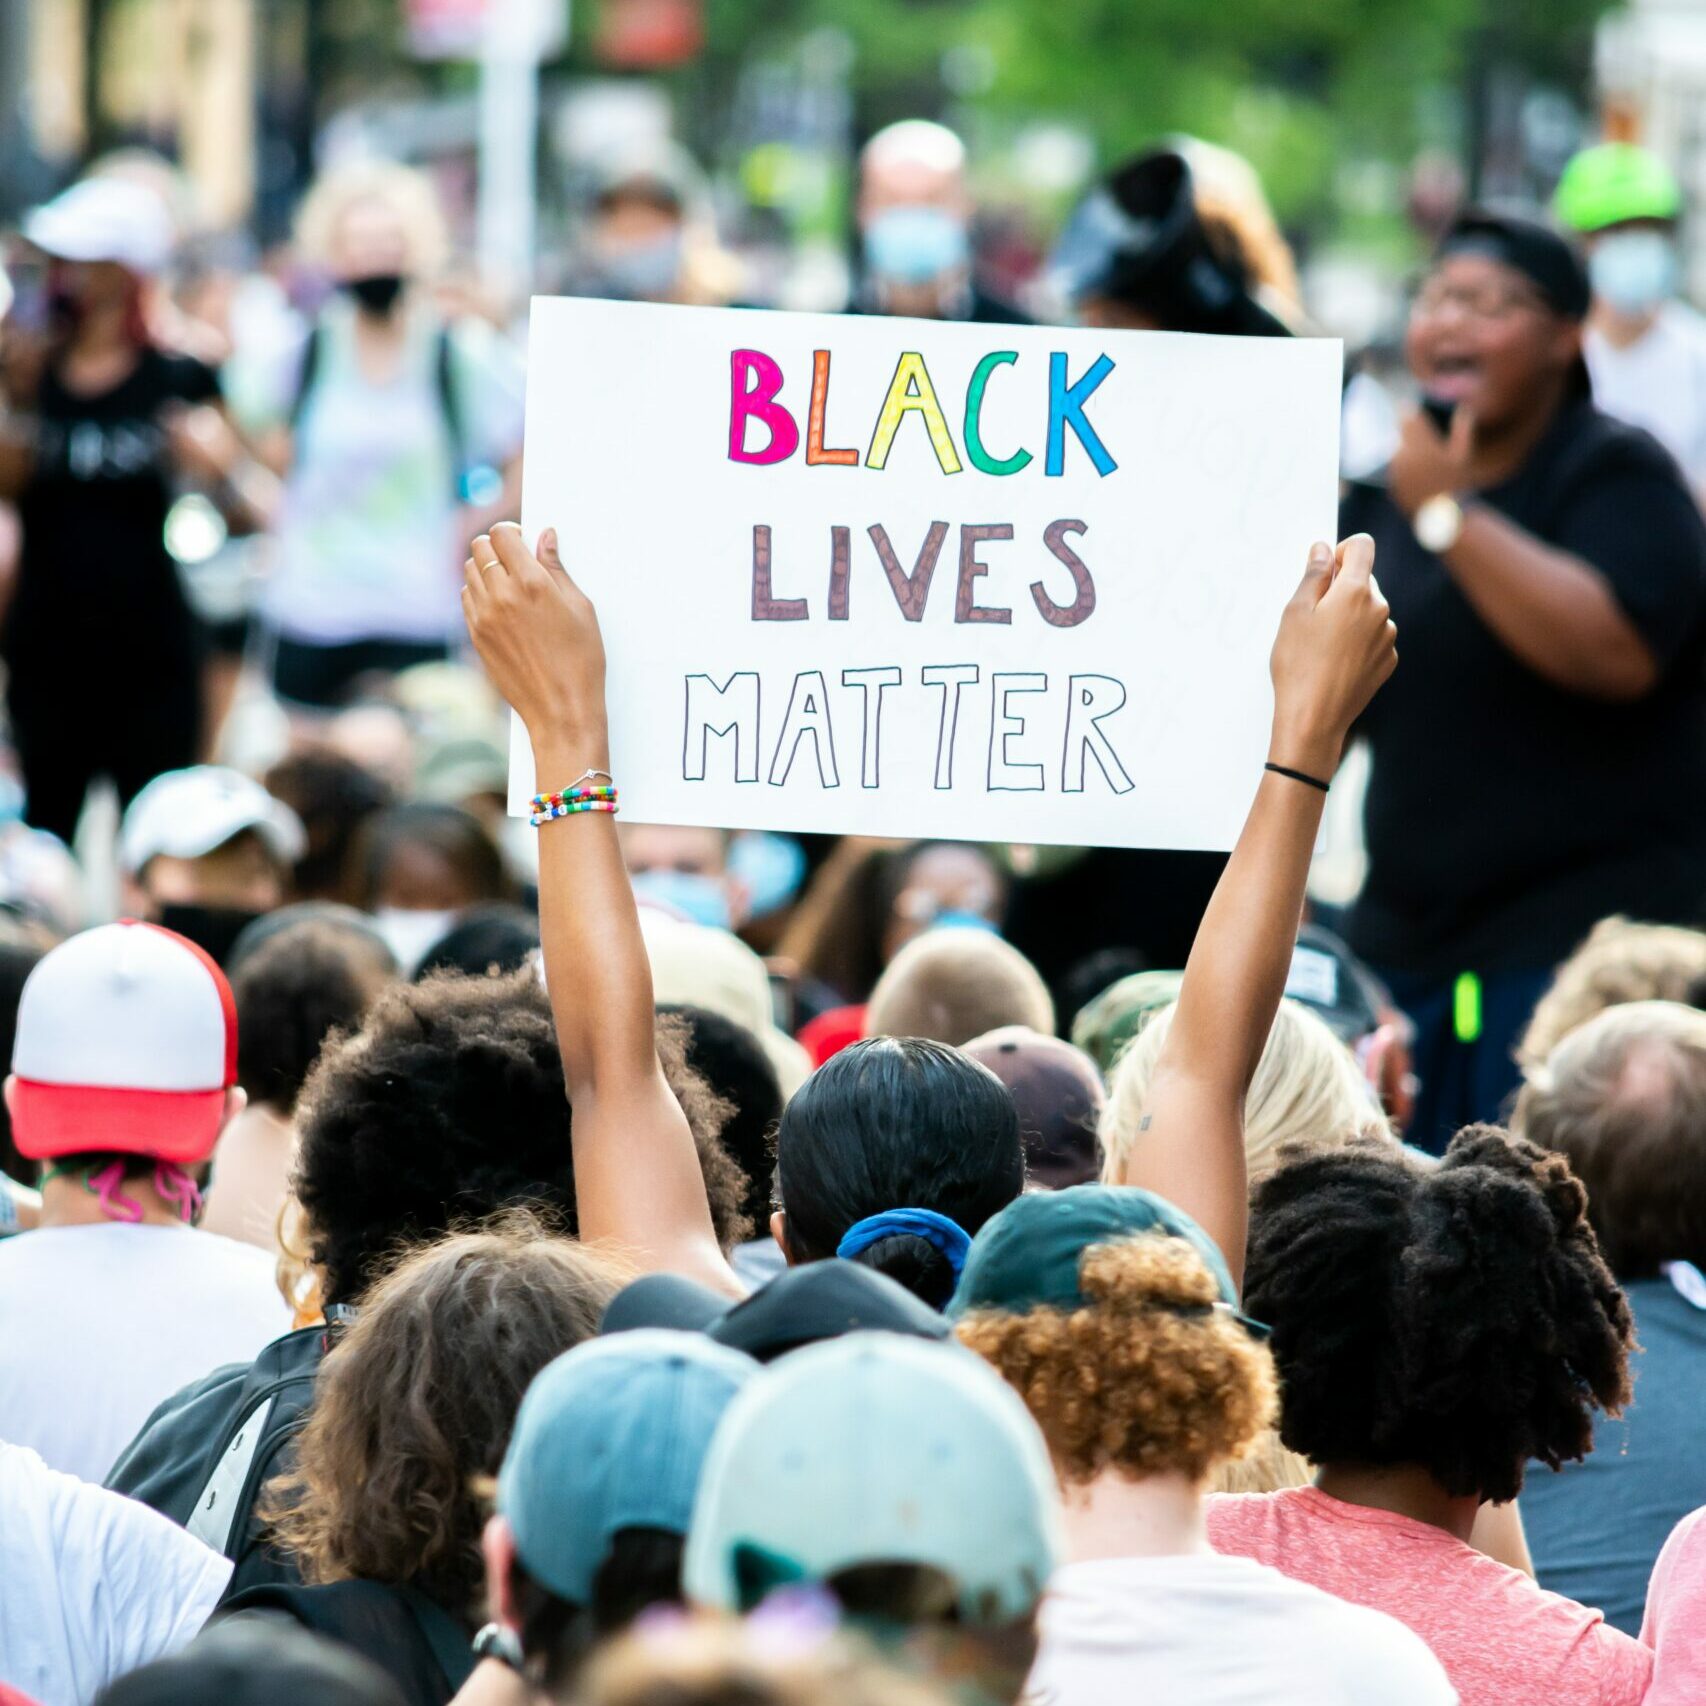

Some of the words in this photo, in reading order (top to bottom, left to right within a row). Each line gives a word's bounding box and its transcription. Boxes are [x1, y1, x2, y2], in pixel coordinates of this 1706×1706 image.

[727, 348, 1119, 479] BLACK
[751, 518, 1097, 629] LIVES
[682, 663, 1136, 795] MATTER
